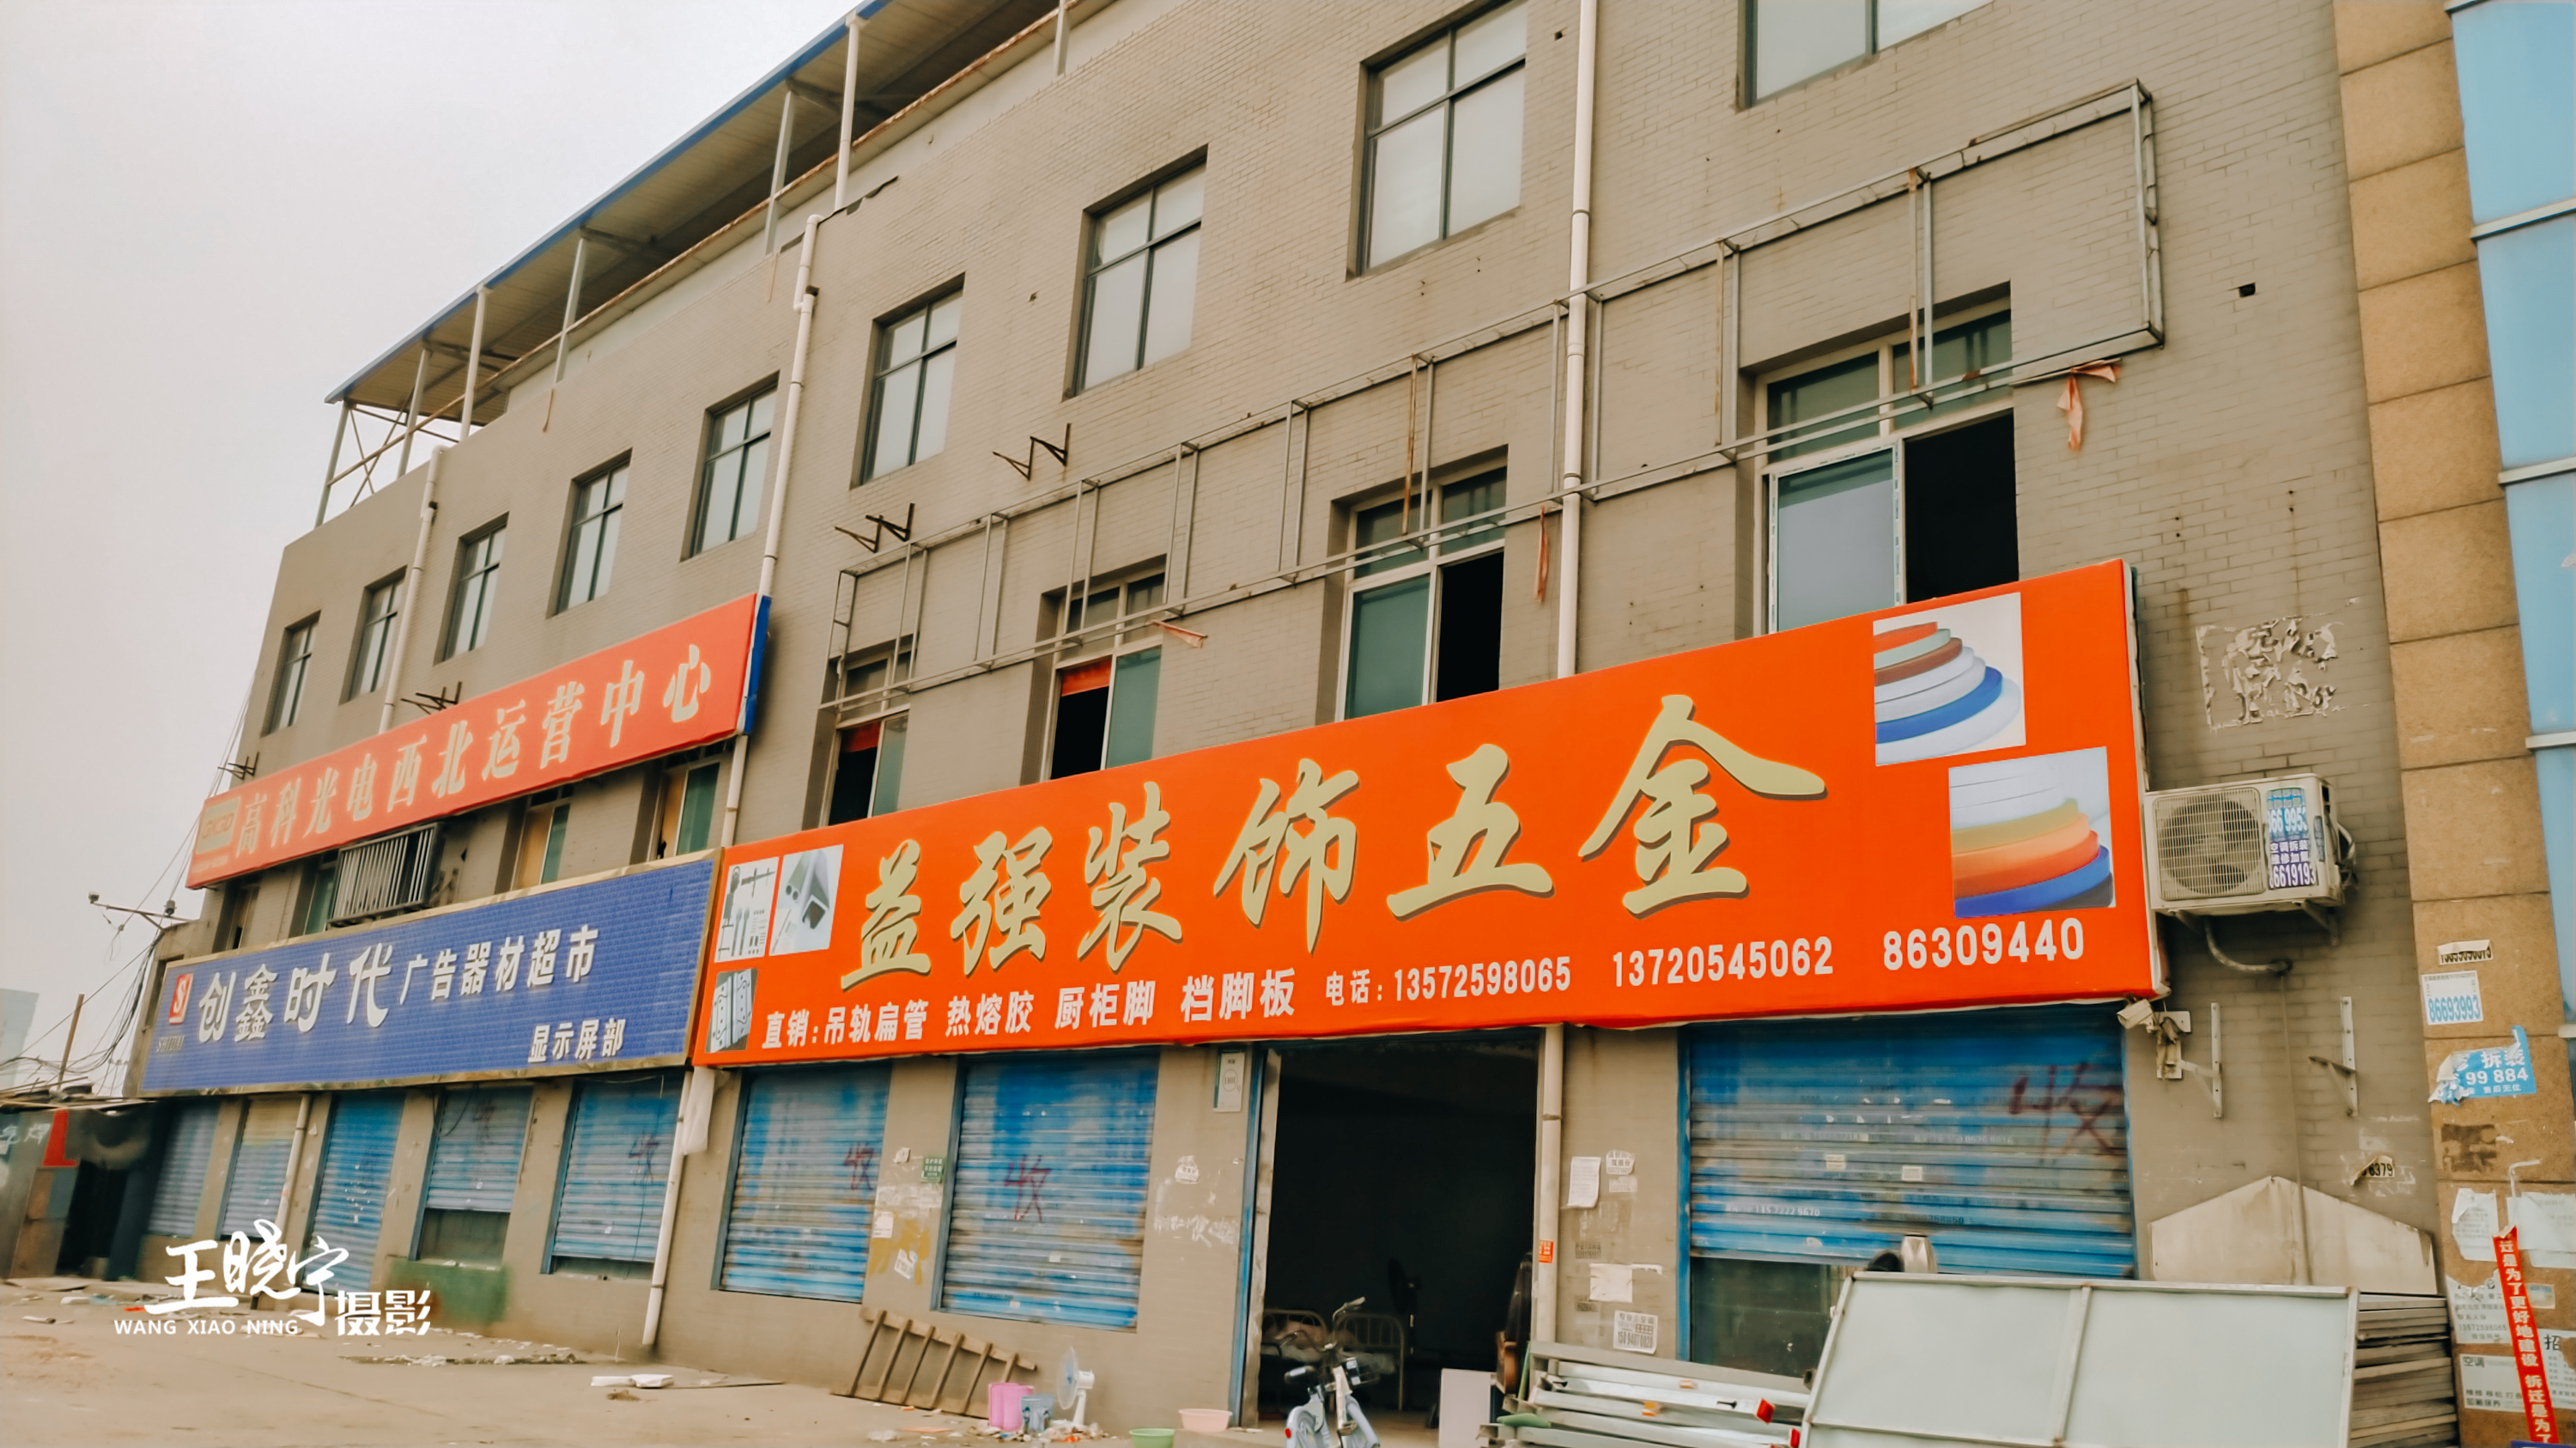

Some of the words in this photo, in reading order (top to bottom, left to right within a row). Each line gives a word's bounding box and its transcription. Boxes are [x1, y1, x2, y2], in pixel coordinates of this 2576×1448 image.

[235, 643, 711, 858] 高科光电西北运营中心
[841, 694, 1827, 990] 益强装饰五金
[399, 925, 598, 1004] 广告器材超市
[1613, 935, 1834, 989] 13720545062
[1882, 916, 2085, 971] 86309440
[198, 942, 393, 1043] 创鑫时代
[945, 990, 1035, 1039] 热熔胶
[1054, 981, 1157, 1030] 厨柜脚
[1181, 967, 1296, 1025] 档脚板
[2428, 995, 2480, 1022] 86693993
[527, 1018, 627, 1063] 显示屏部
[2463, 1356, 2485, 1368] 空调
